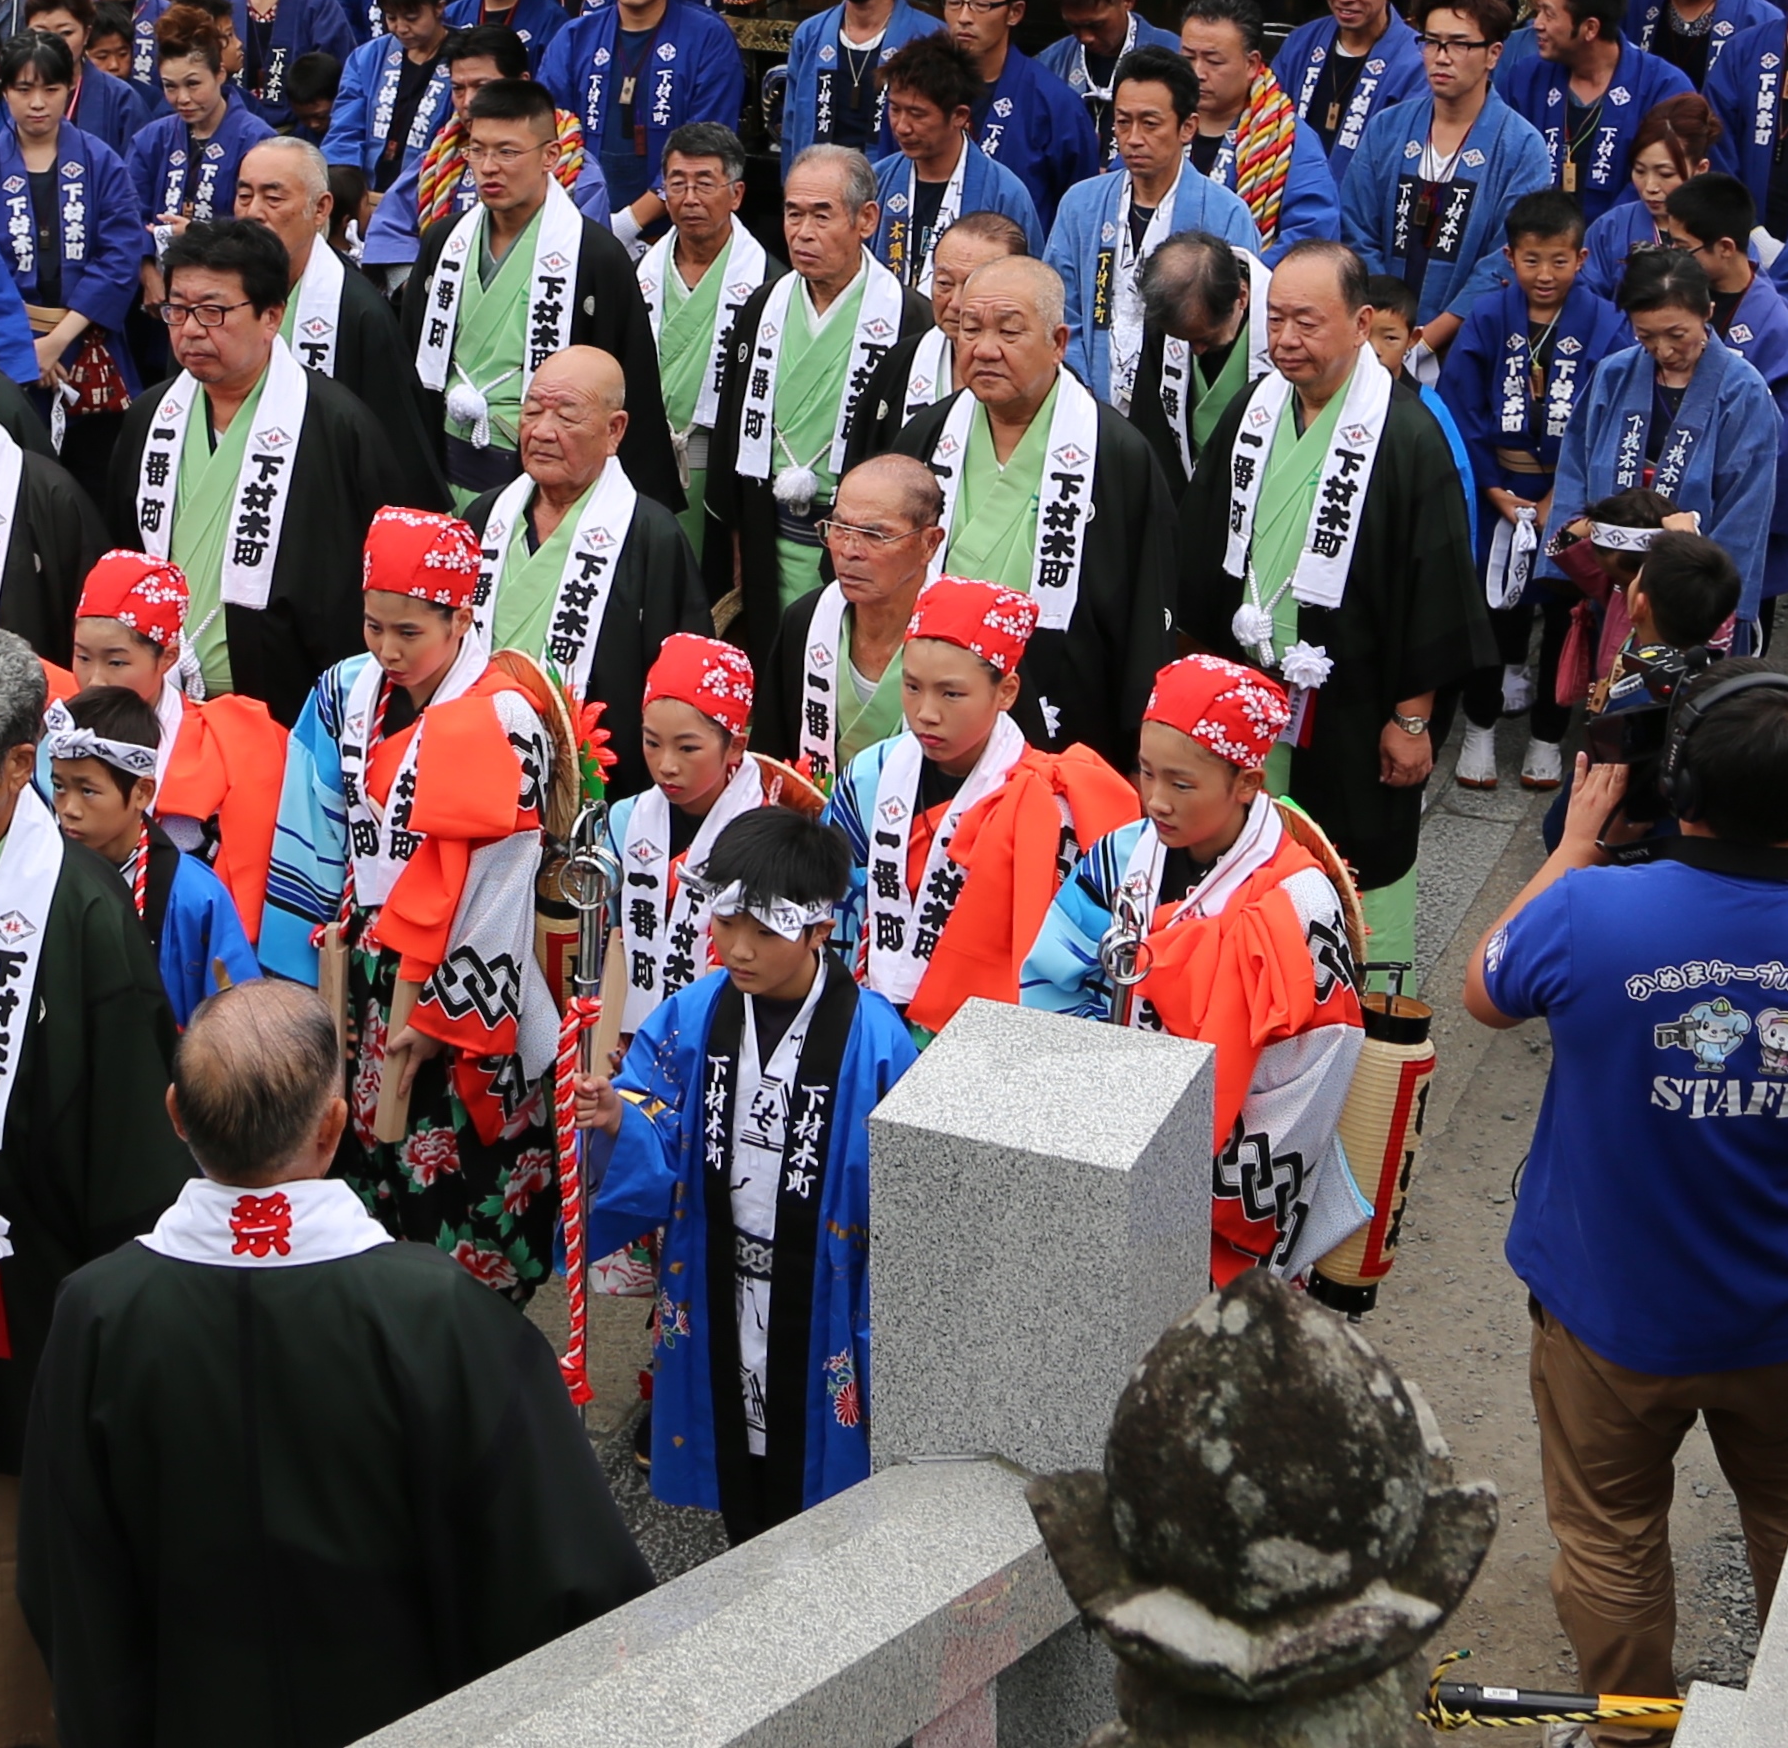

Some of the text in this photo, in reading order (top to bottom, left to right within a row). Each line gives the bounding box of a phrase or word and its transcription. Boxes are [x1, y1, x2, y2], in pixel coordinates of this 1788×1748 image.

[428, 258, 461, 350] 一番町
[744, 346, 773, 441] 一番町
[141, 428, 177, 533] 一番町
[627, 871, 660, 992] 一番町
[872, 830, 907, 955] 一番町
[229, 1190, 294, 1260] 祭
